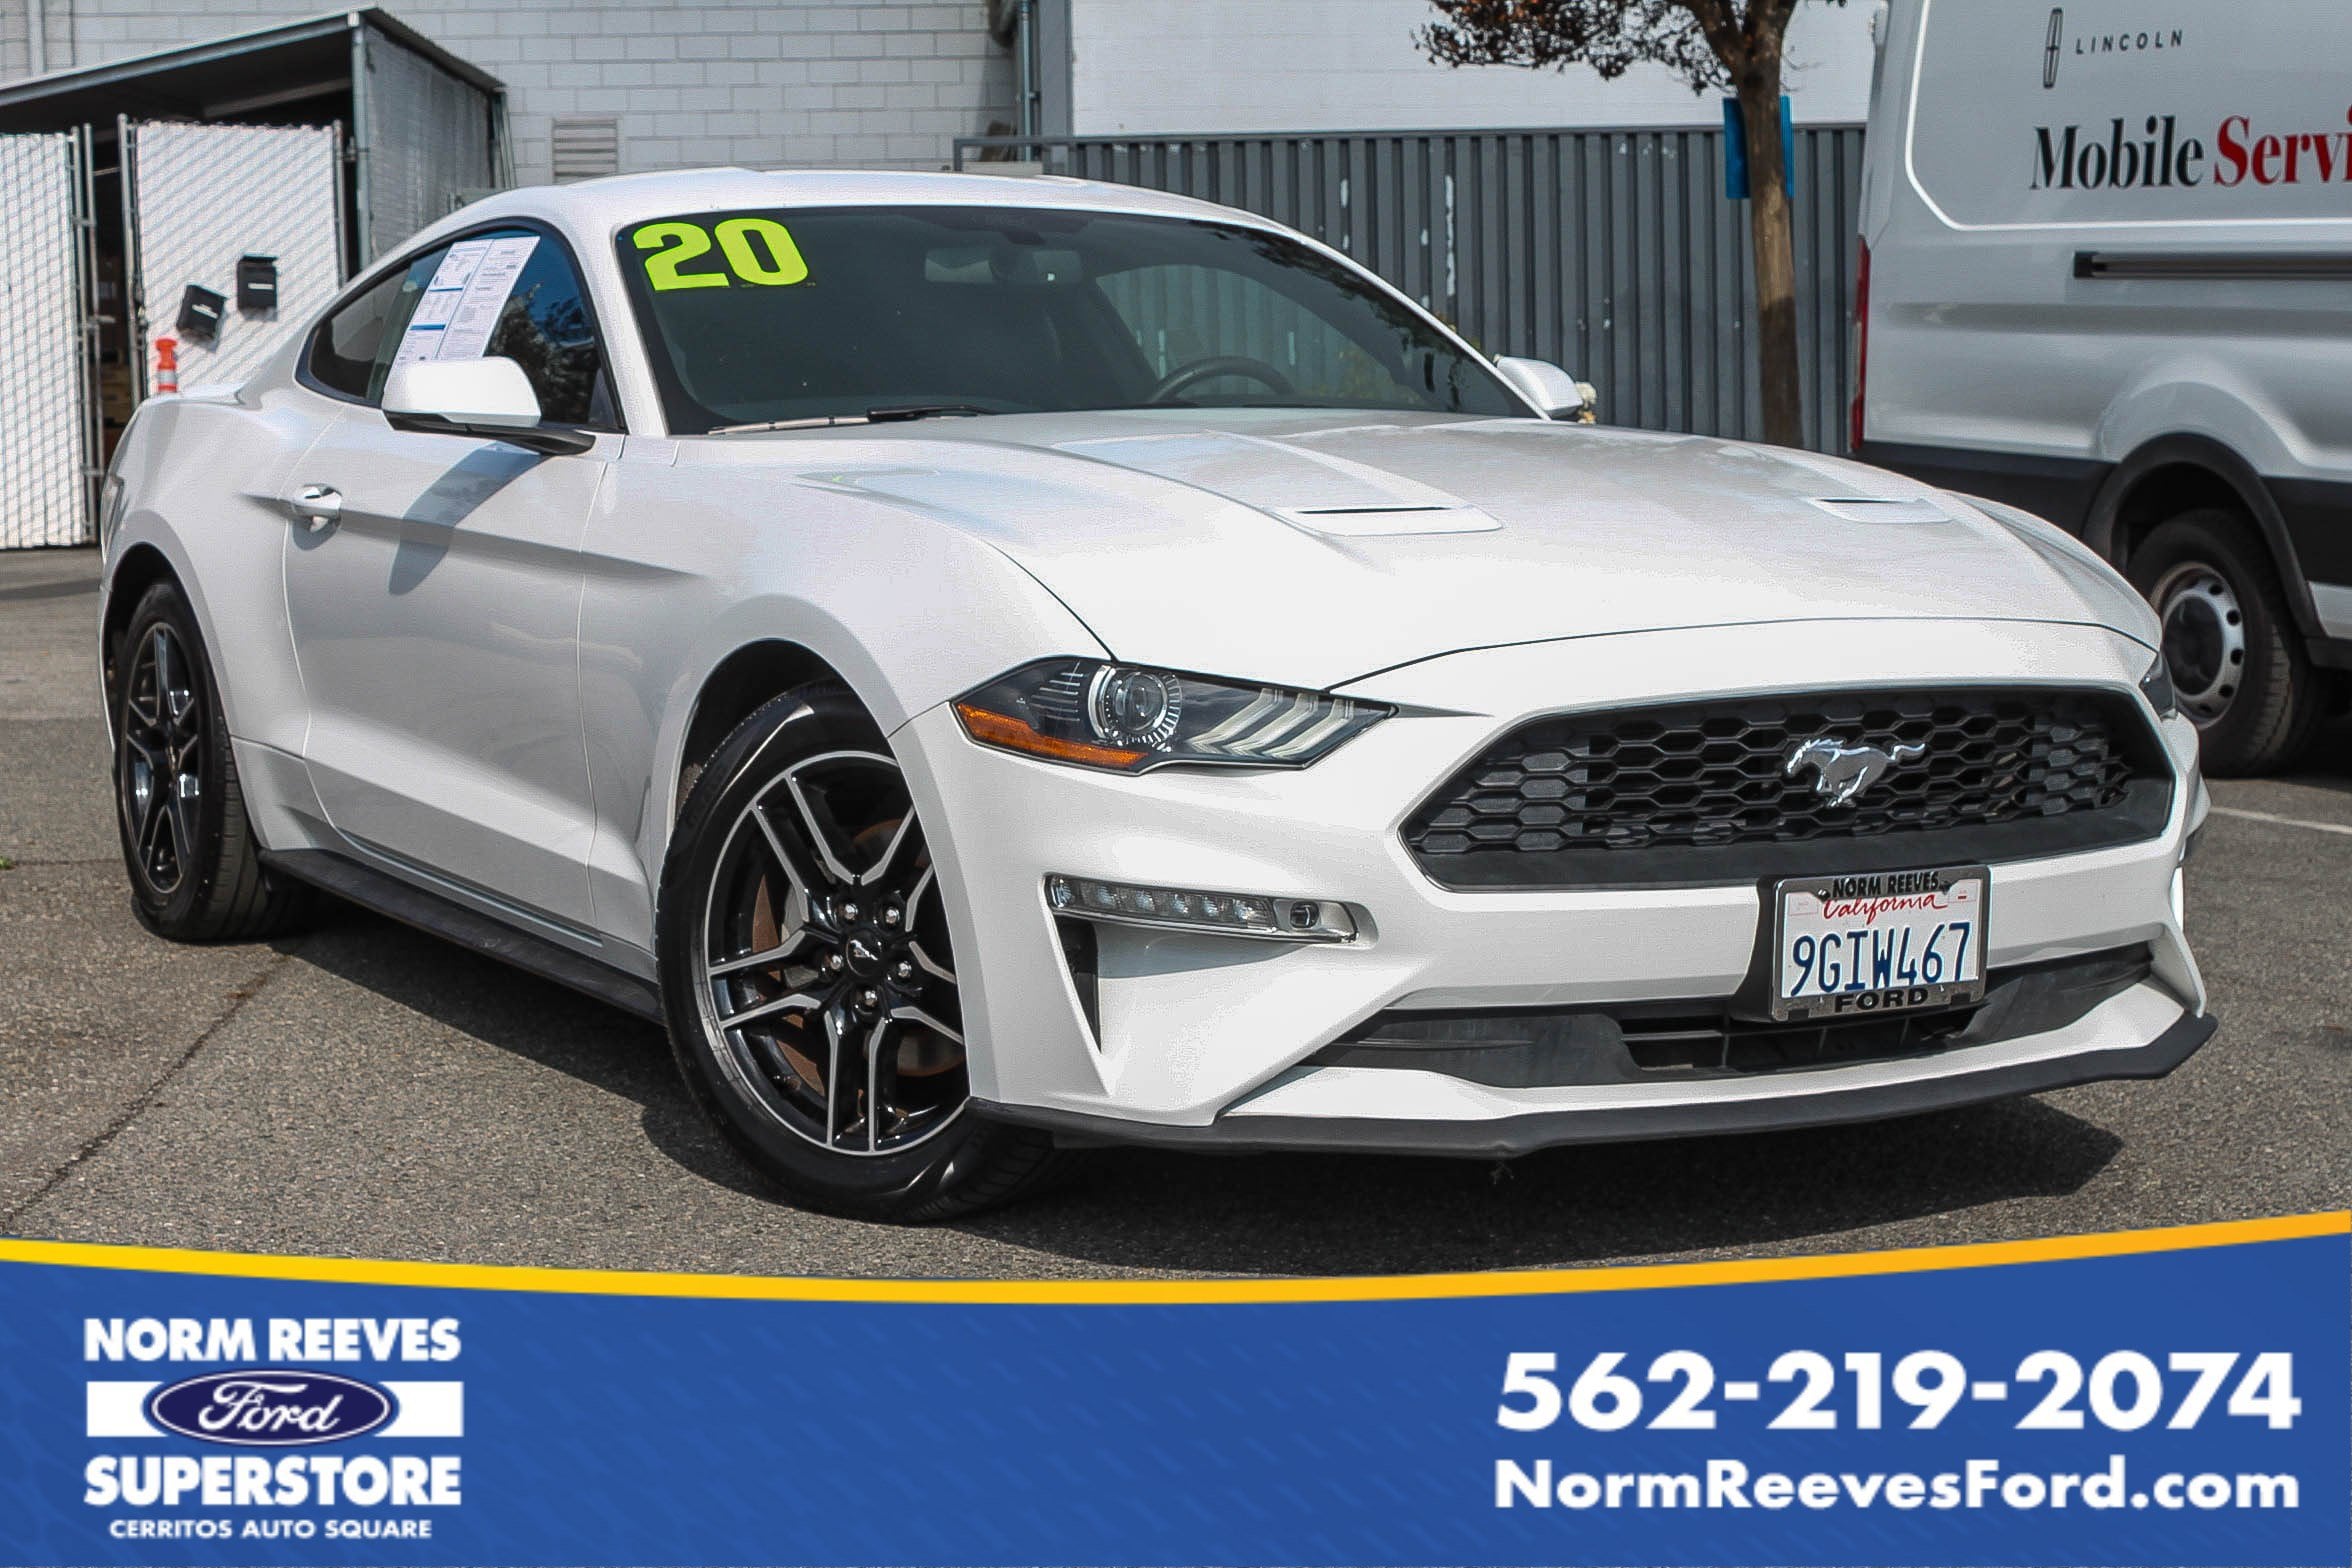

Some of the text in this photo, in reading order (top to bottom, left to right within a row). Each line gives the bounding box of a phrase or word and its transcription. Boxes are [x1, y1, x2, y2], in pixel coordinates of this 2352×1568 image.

[2076, 29, 2184, 54] LINCOLN
[2029, 115, 2204, 190] Mobile
[632, 217, 809, 292] 20
[1832, 877, 1882, 898] NORM
[1887, 871, 1940, 895] REEVES
[1822, 893, 1948, 926] California
[1790, 921, 1971, 997] 9GIW467
[1834, 987, 1929, 1013] FORD
